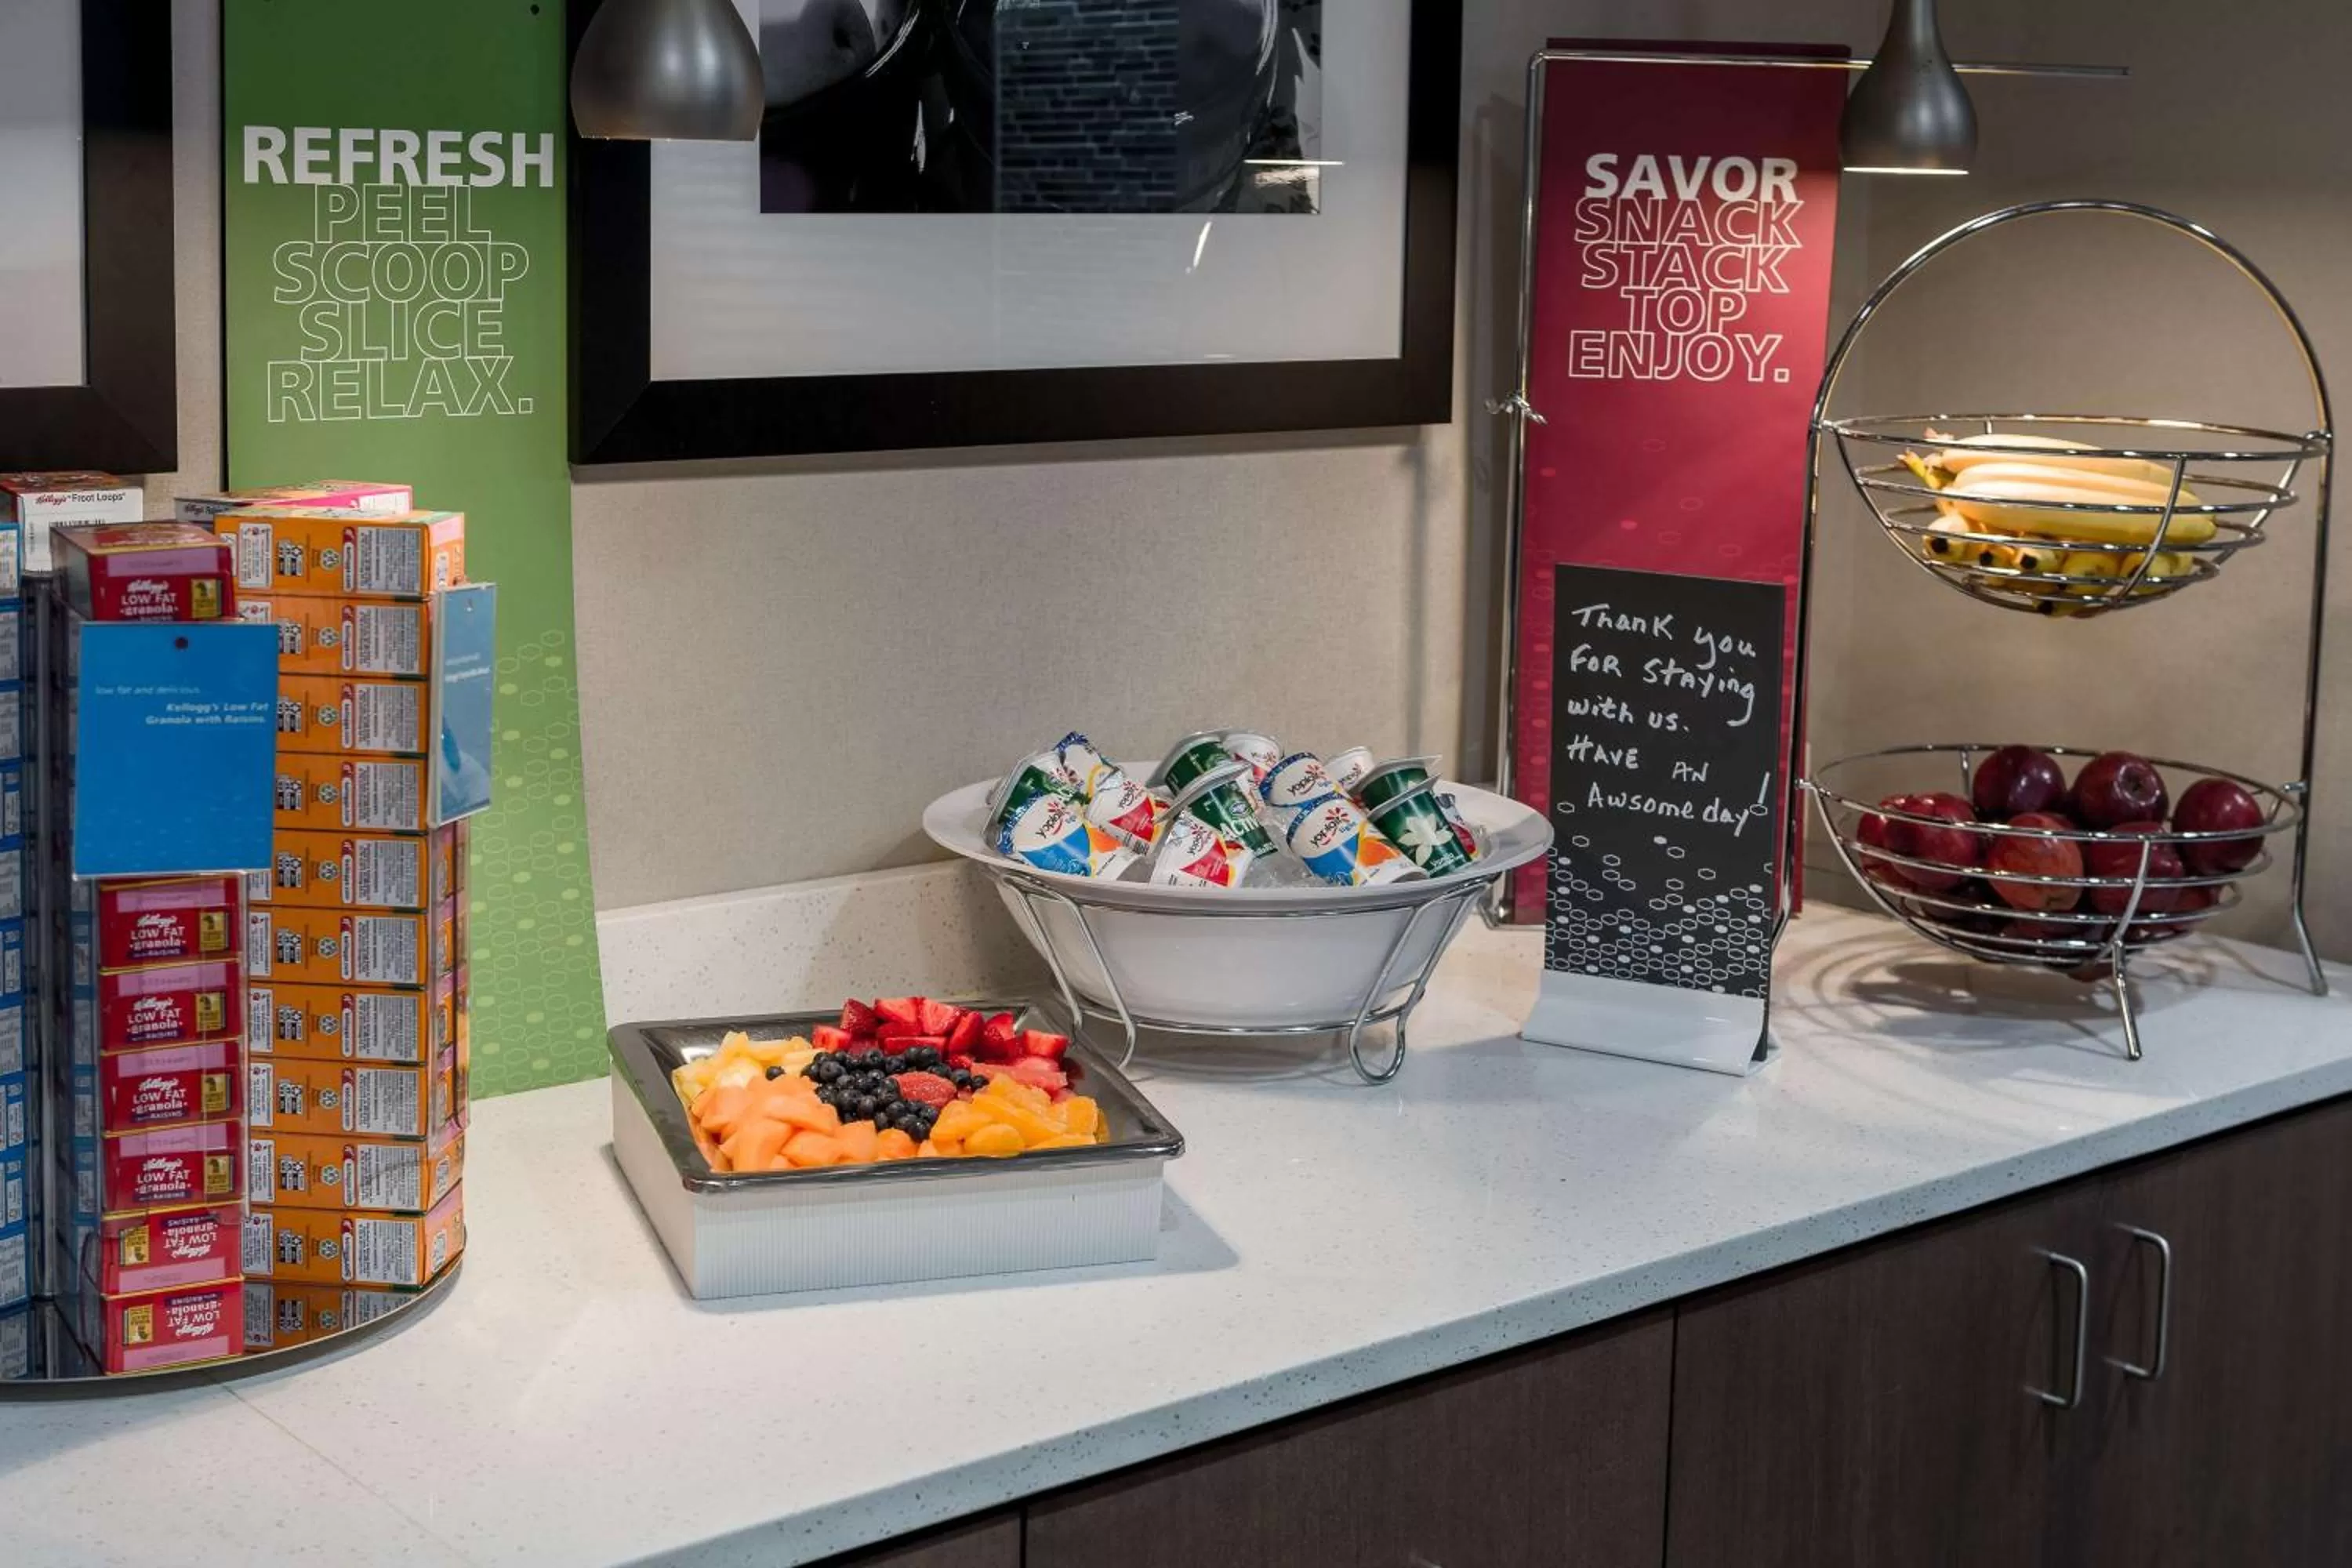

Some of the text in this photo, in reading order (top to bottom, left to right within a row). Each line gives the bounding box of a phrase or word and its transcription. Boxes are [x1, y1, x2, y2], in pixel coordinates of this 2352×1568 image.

[244, 125, 554, 187] REFRESH
[1584, 153, 1799, 202] SAVOR
[315, 183, 492, 243] PEEL
[1574, 197, 1804, 248] SNACK
[273, 241, 529, 303] SCOOP
[1581, 242, 1791, 293] STACK
[299, 300, 504, 362] SLICE
[1621, 286, 1747, 336] TOP
[1569, 330, 1790, 383] ENJOY.
[267, 356, 534, 423] RELAX.
[96, 493, 122, 503] Loops
[121, 593, 177, 606] LOW FAT
[1693, 626, 1757, 670] you
[1567, 695, 1634, 724] with
[1671, 760, 1710, 782] AN
[130, 926, 185, 940] LOW FAT
[127, 1007, 182, 1024] LOW FAT
[132, 1088, 187, 1105] LOW FAT
[137, 1169, 191, 1183] LOW FAT
[163, 1232, 217, 1248] LOW FAT
[167, 1311, 220, 1327] LOW FAT
